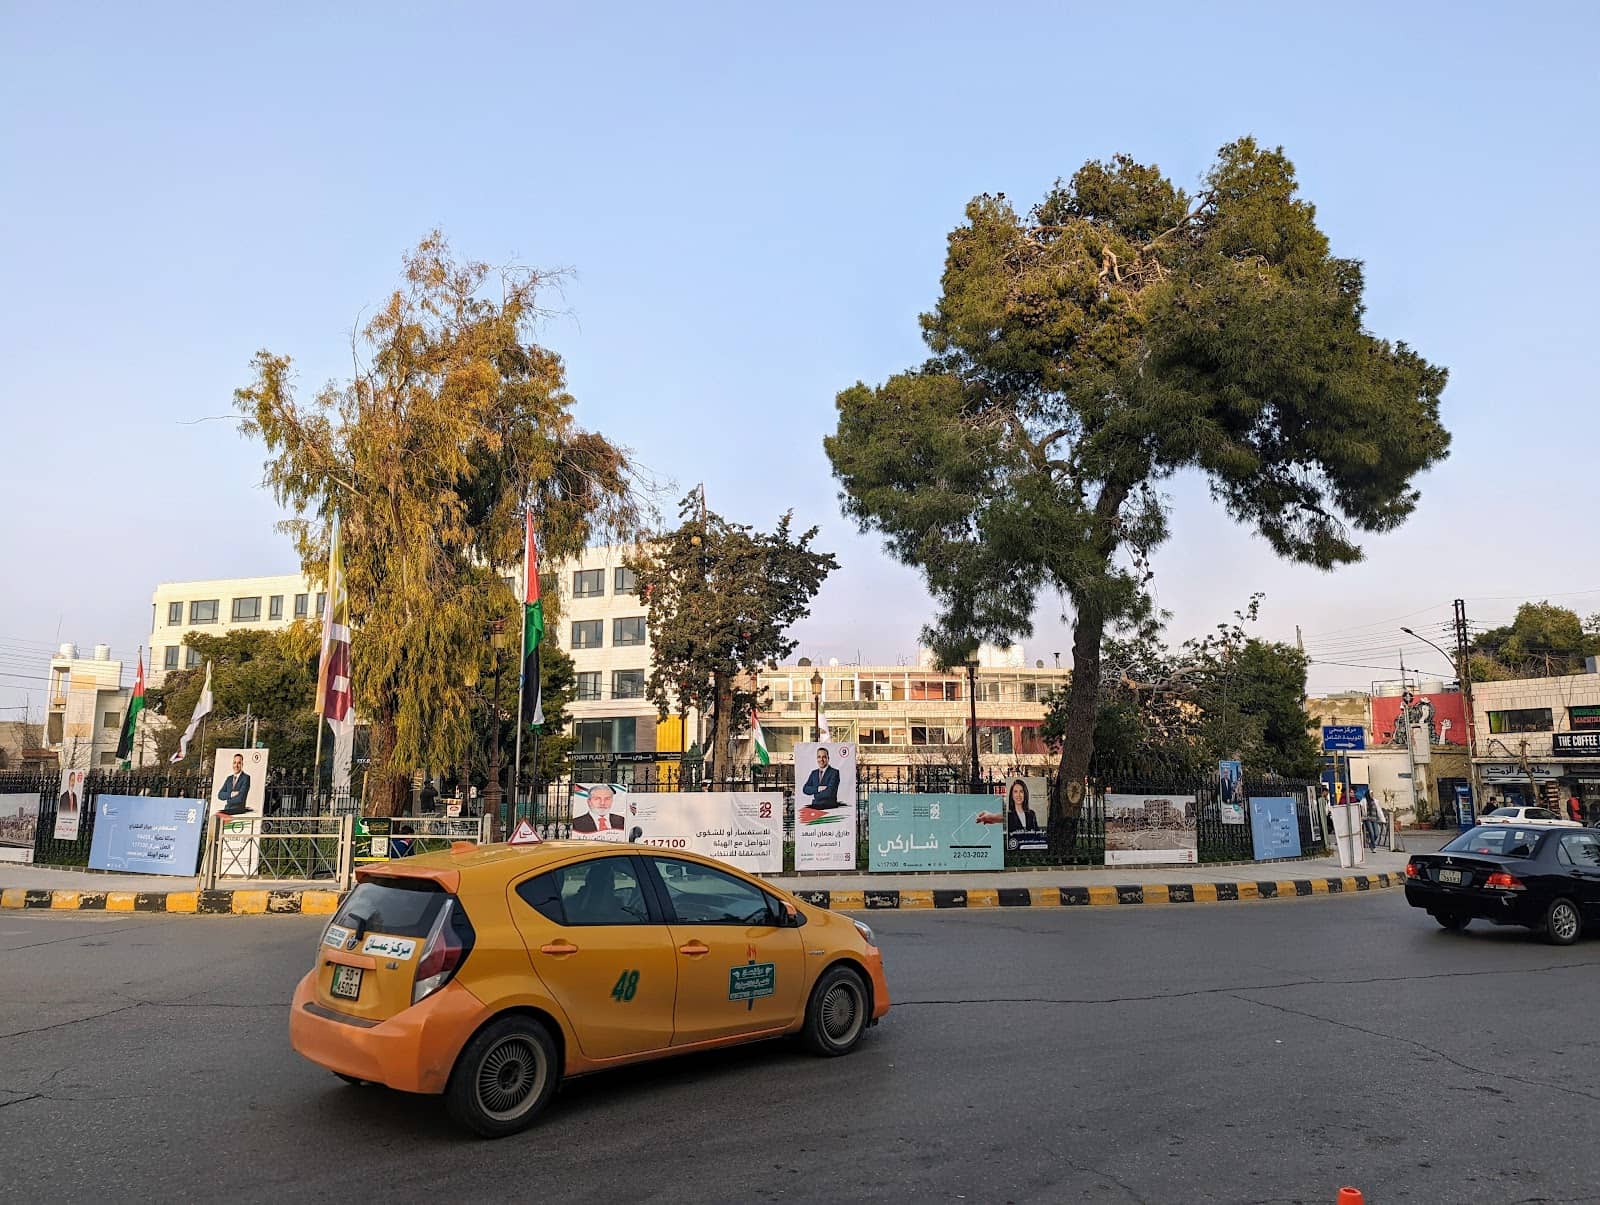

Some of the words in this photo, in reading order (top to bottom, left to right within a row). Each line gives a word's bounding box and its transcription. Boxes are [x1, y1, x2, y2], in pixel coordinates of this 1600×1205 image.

[1558, 735, 1571, 747] THE
[1572, 735, 1598, 747] COFFEE
[726, 826, 733, 837] أو
[643, 839, 686, 848] 117100
[878, 832, 938, 857] شاركي
[953, 851, 989, 859] 22-03-2022
[386, 941, 411, 957] مركز
[610, 970, 641, 1002] 48
